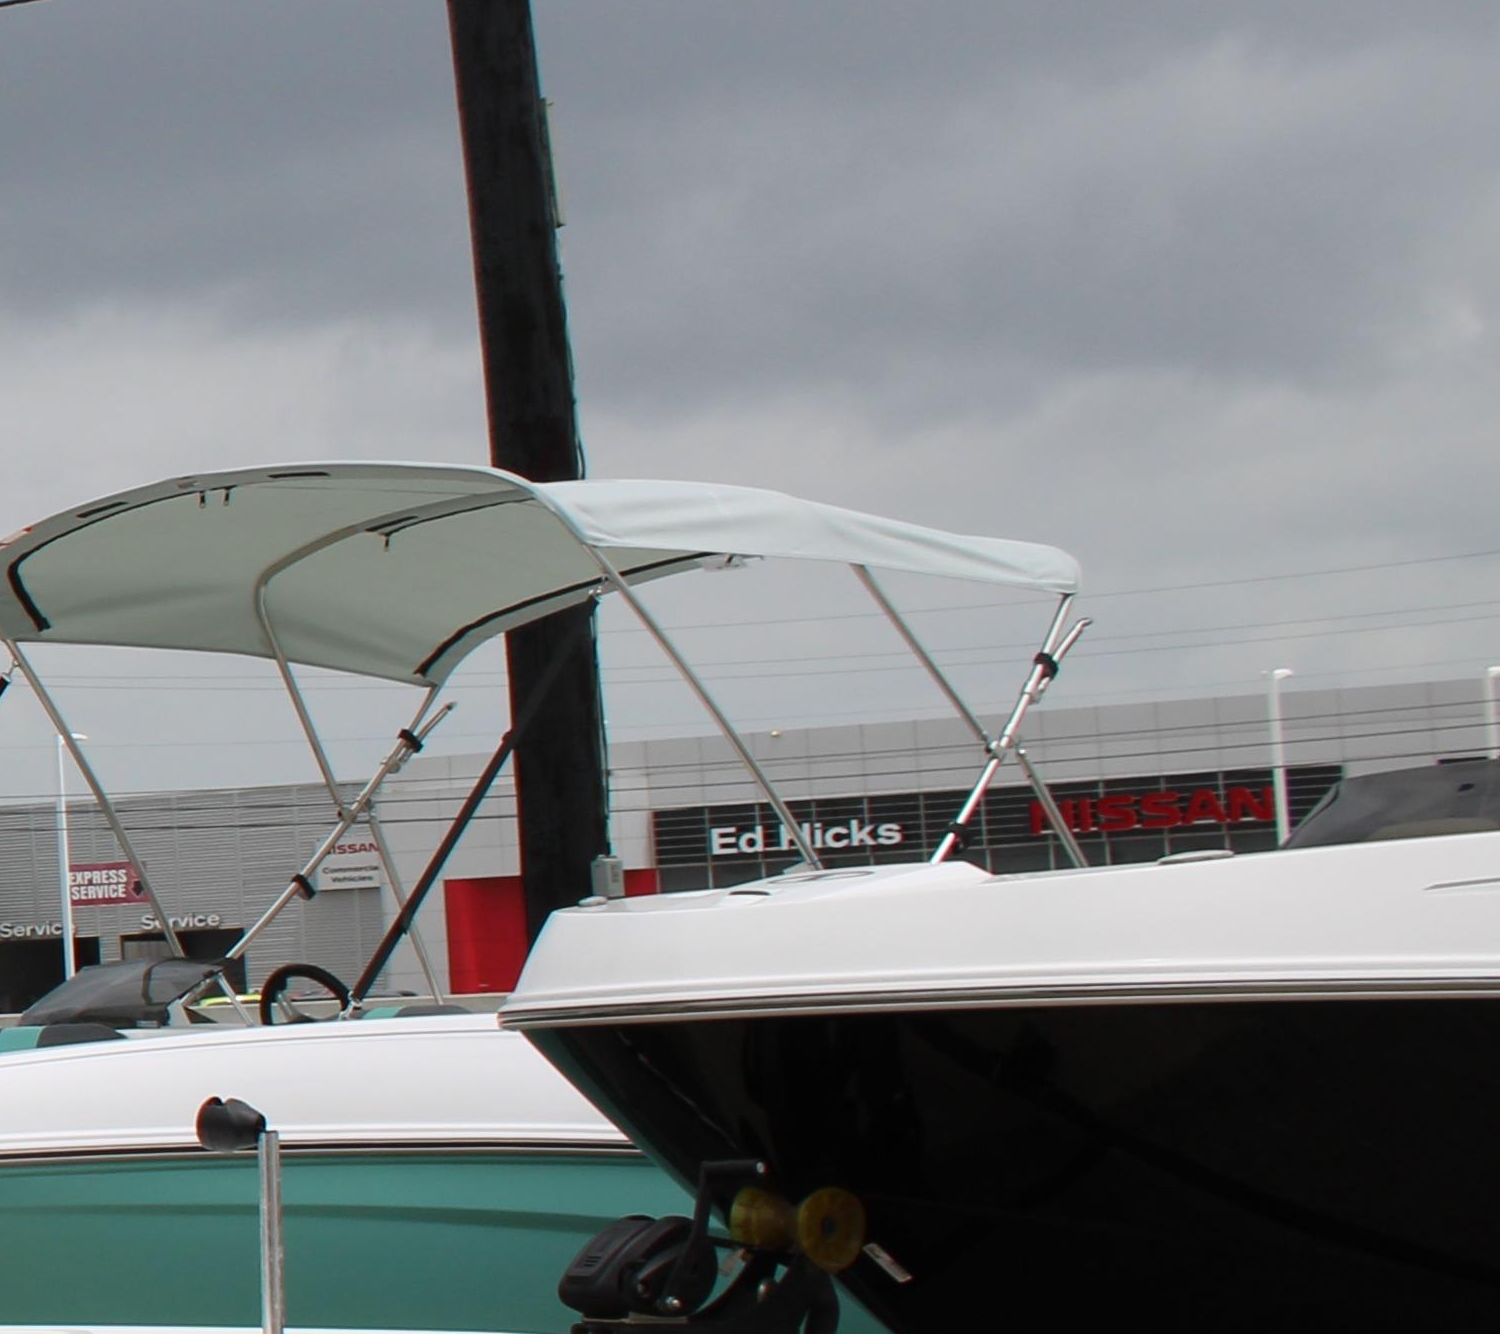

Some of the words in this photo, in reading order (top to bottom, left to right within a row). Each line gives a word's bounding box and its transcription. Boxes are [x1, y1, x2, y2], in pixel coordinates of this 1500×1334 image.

[1029, 786, 1275, 836] NISSAN
[711, 825, 764, 855] Ed
[780, 819, 903, 851] Hicks
[329, 842, 380, 855] ISSAN
[69, 869, 128, 885] EXPRESS
[71, 884, 127, 900] SERVICE
[0, 921, 75, 938] Servic
